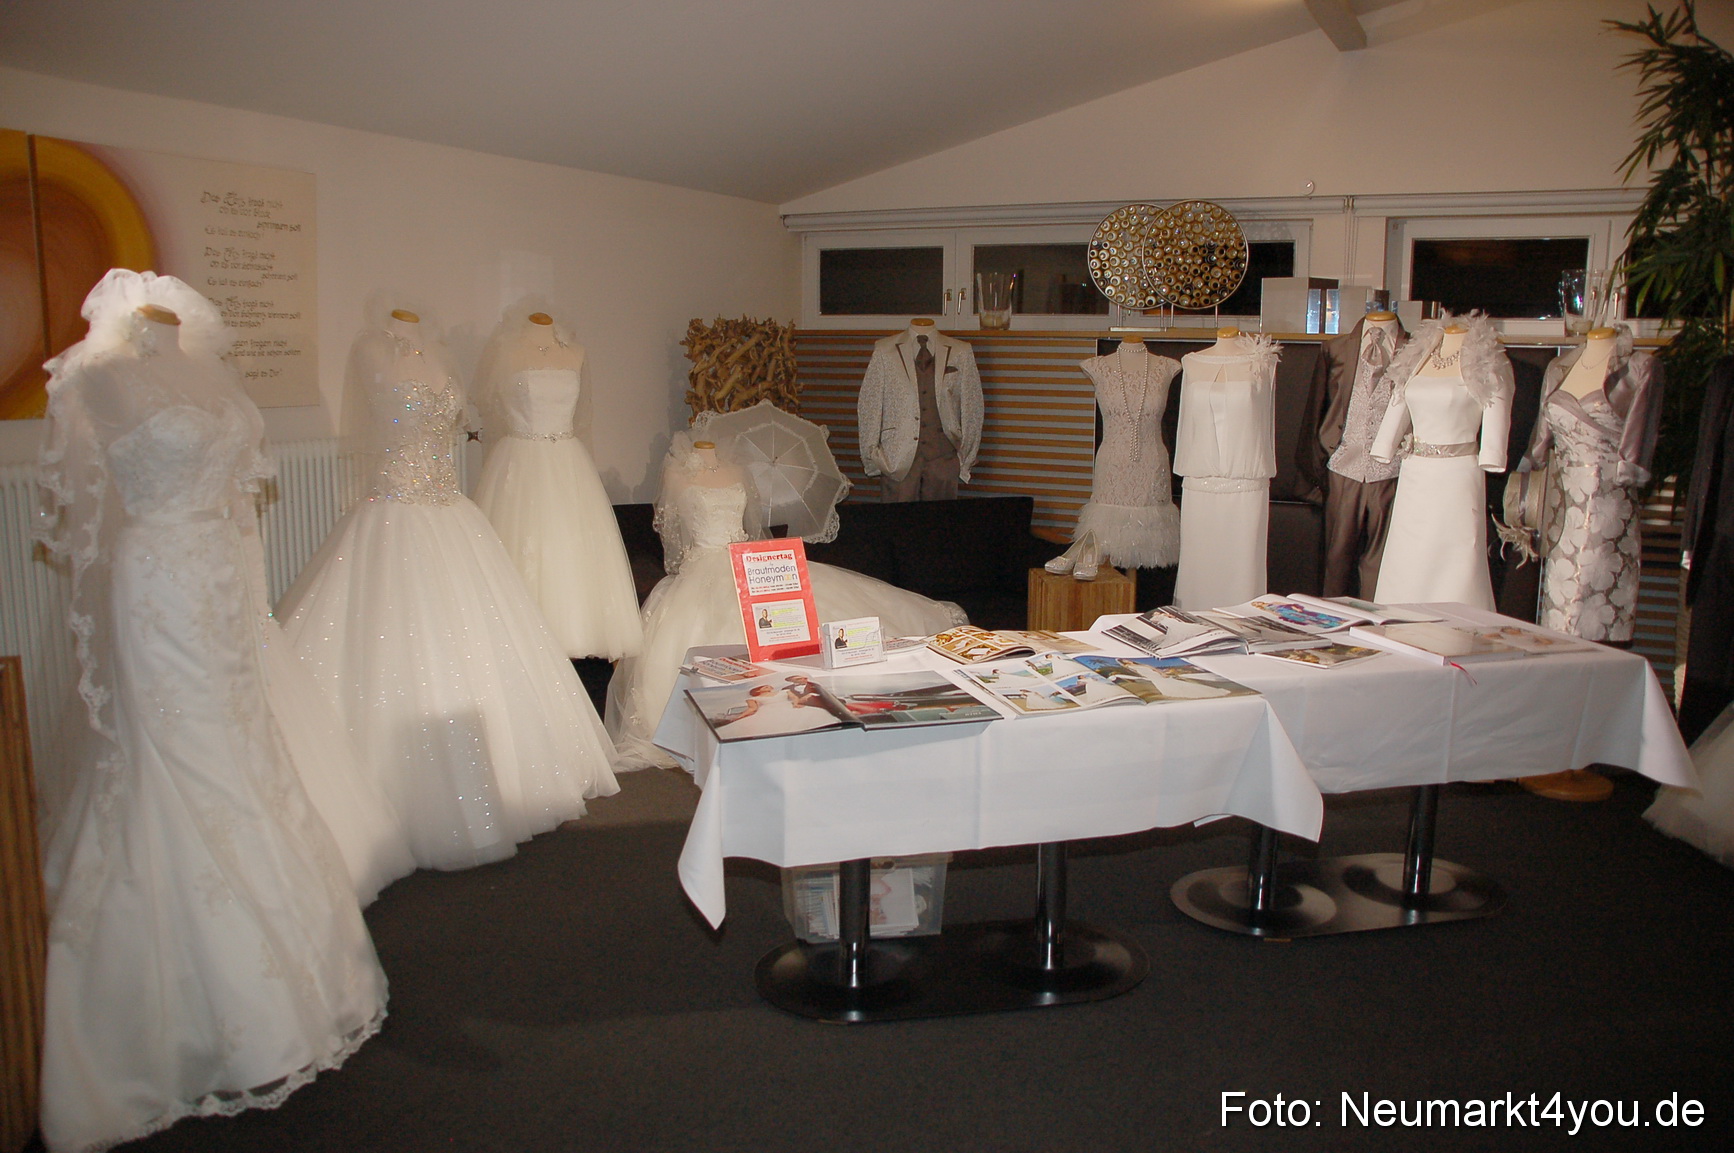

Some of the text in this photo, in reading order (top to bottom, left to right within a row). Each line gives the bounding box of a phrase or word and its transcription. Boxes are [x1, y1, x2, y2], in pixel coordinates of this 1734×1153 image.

[745, 553, 793, 562] Designertag
[747, 565, 796, 576] Brautmoden
[749, 573, 798, 584] Honeymoon
